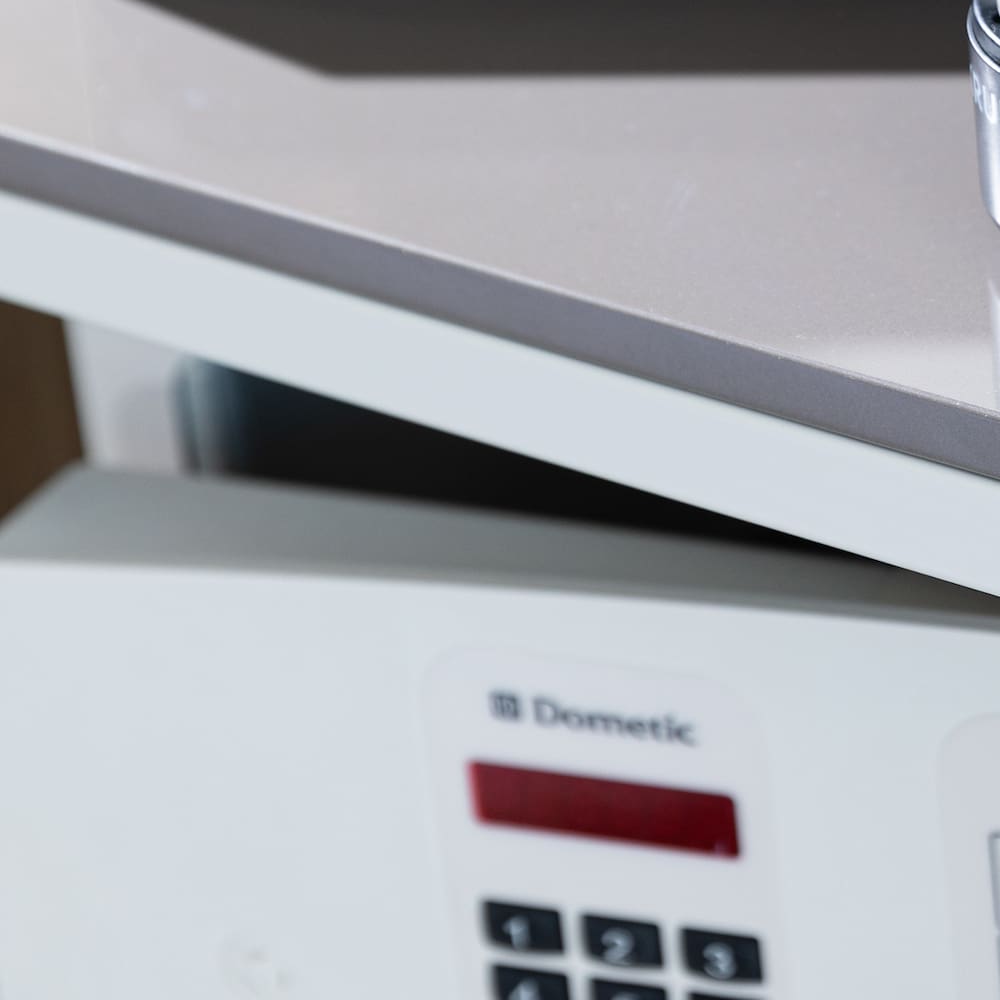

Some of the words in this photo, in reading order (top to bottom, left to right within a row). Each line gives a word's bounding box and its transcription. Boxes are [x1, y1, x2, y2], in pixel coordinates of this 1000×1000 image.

[531, 696, 698, 746] Dometic
[502, 914, 530, 949] 1
[600, 927, 635, 966] 2
[702, 941, 737, 980] 3
